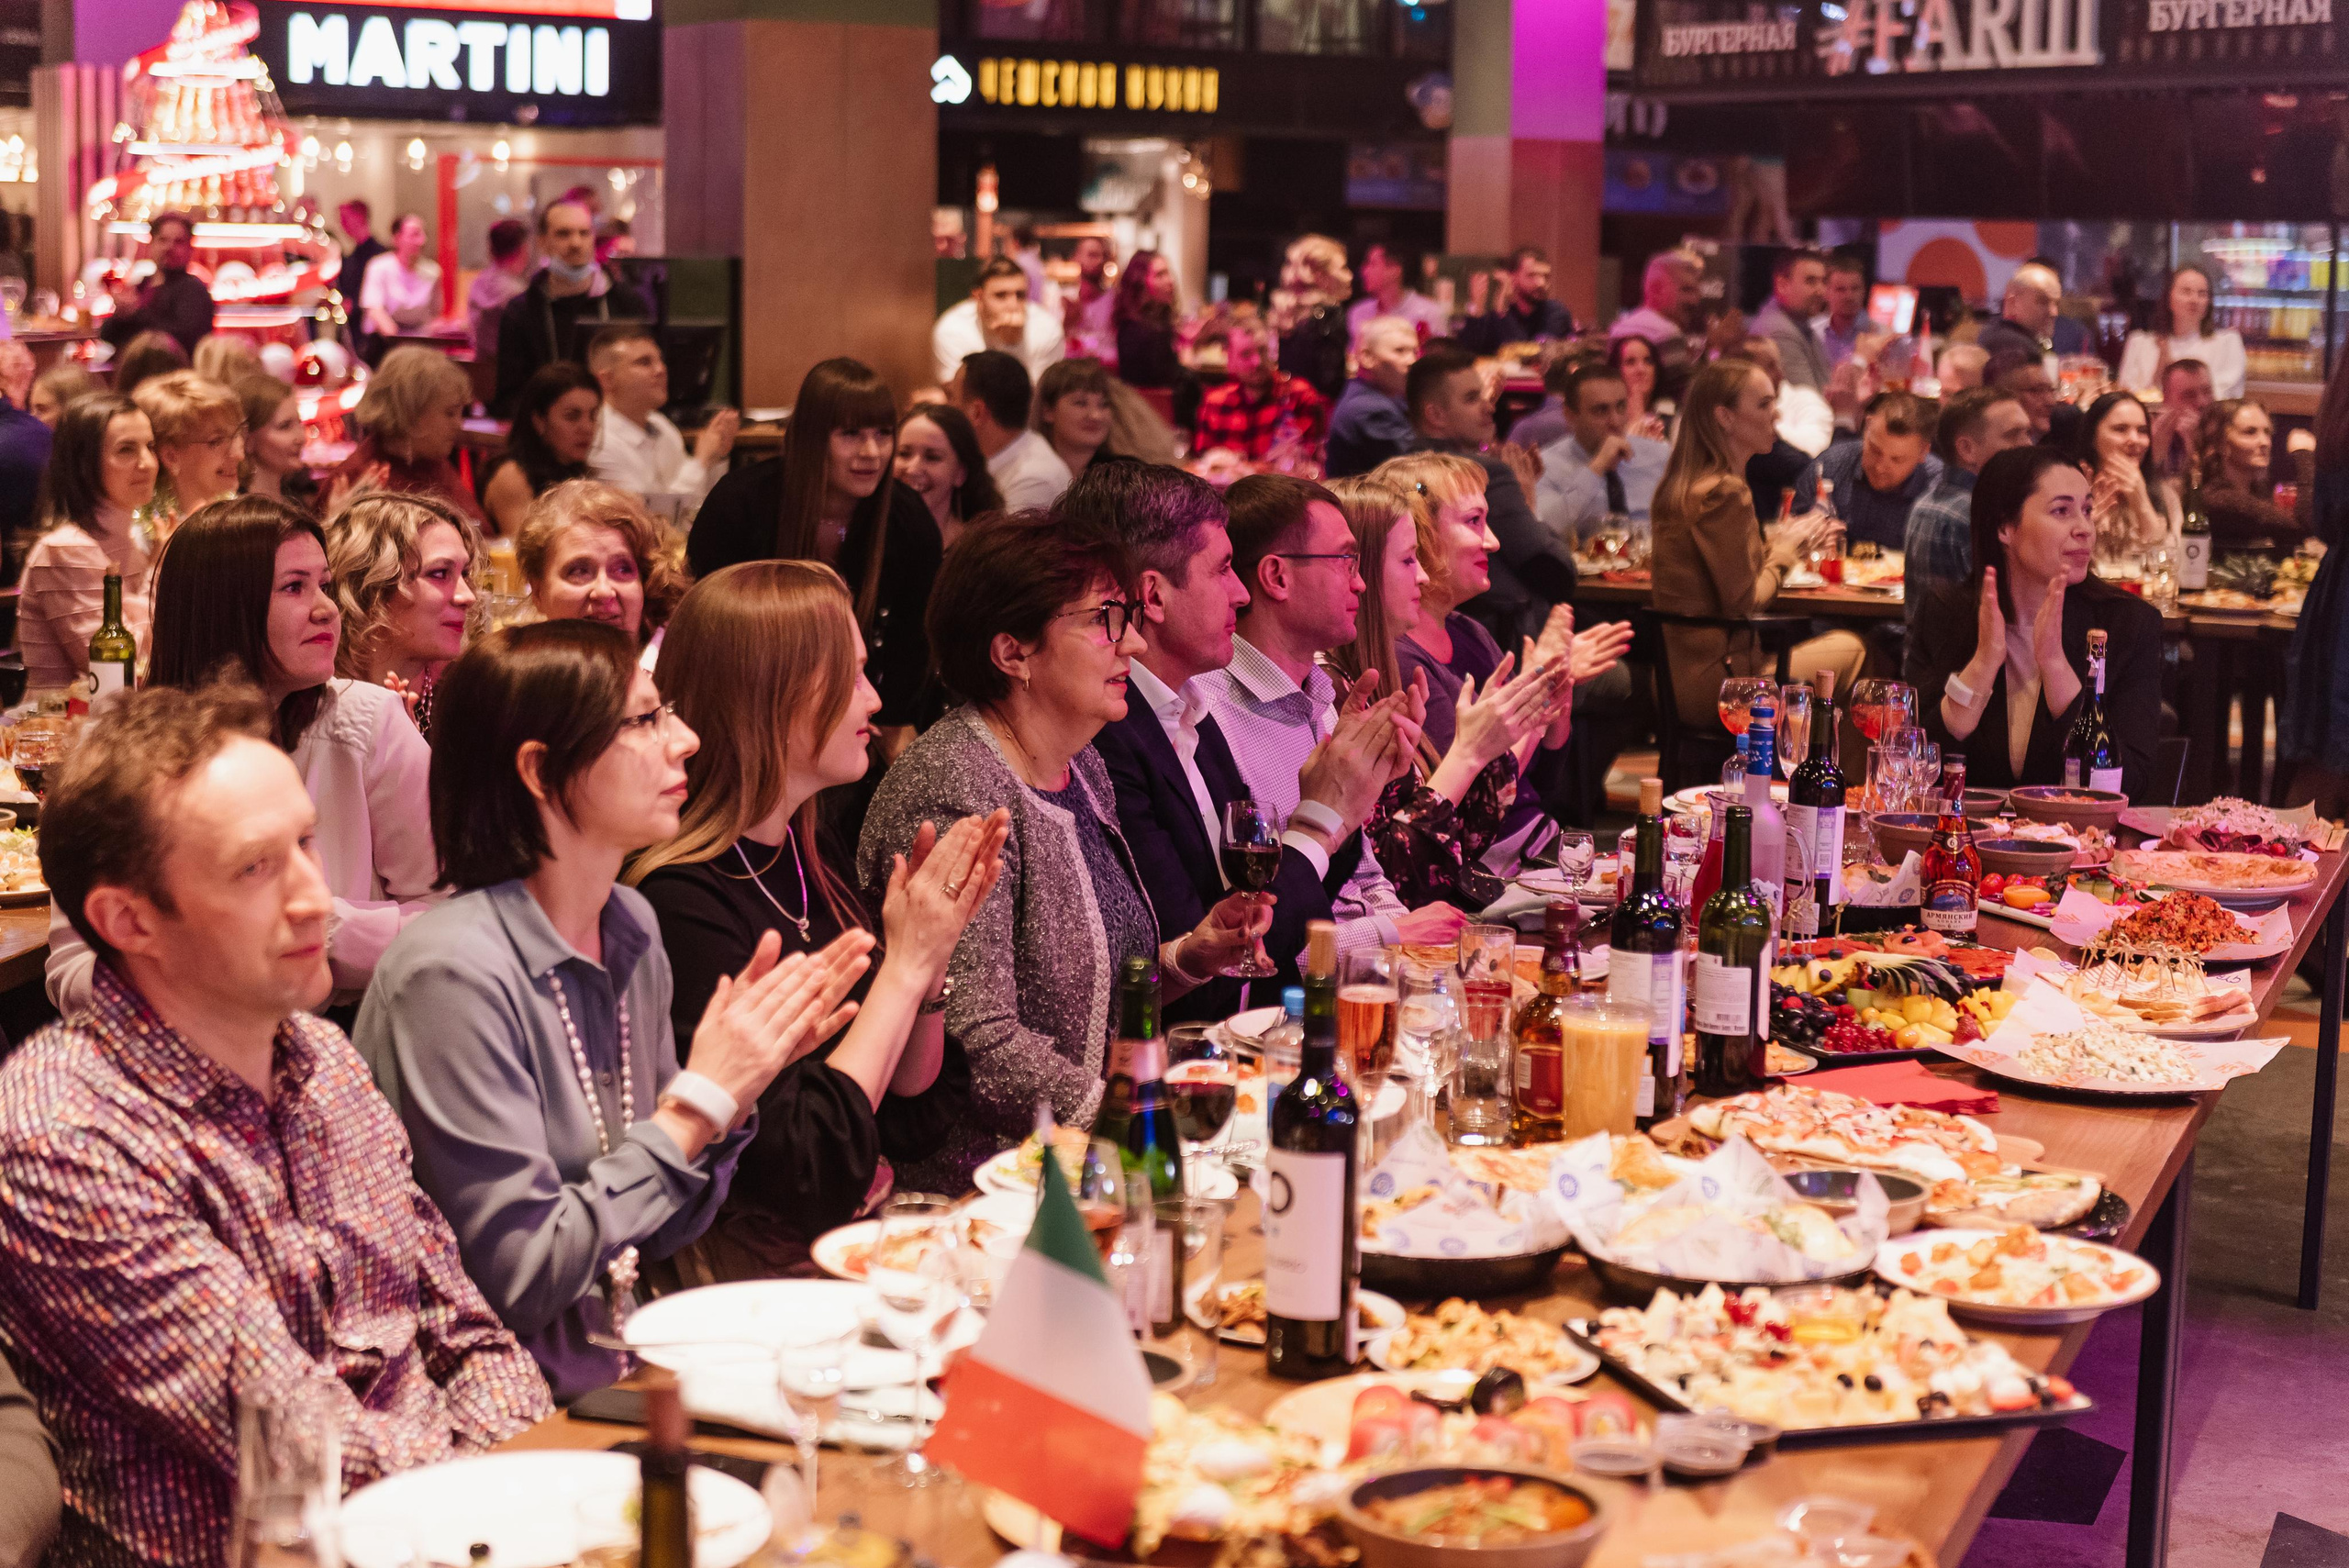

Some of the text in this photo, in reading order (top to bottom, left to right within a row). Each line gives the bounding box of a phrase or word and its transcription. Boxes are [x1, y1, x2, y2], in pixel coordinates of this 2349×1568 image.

[288, 11, 609, 97] MARTINI
[1661, 21, 1797, 57] БУРГЕРНАЯ
[1926, 912, 1973, 920] АРМЯНСКИЙ
